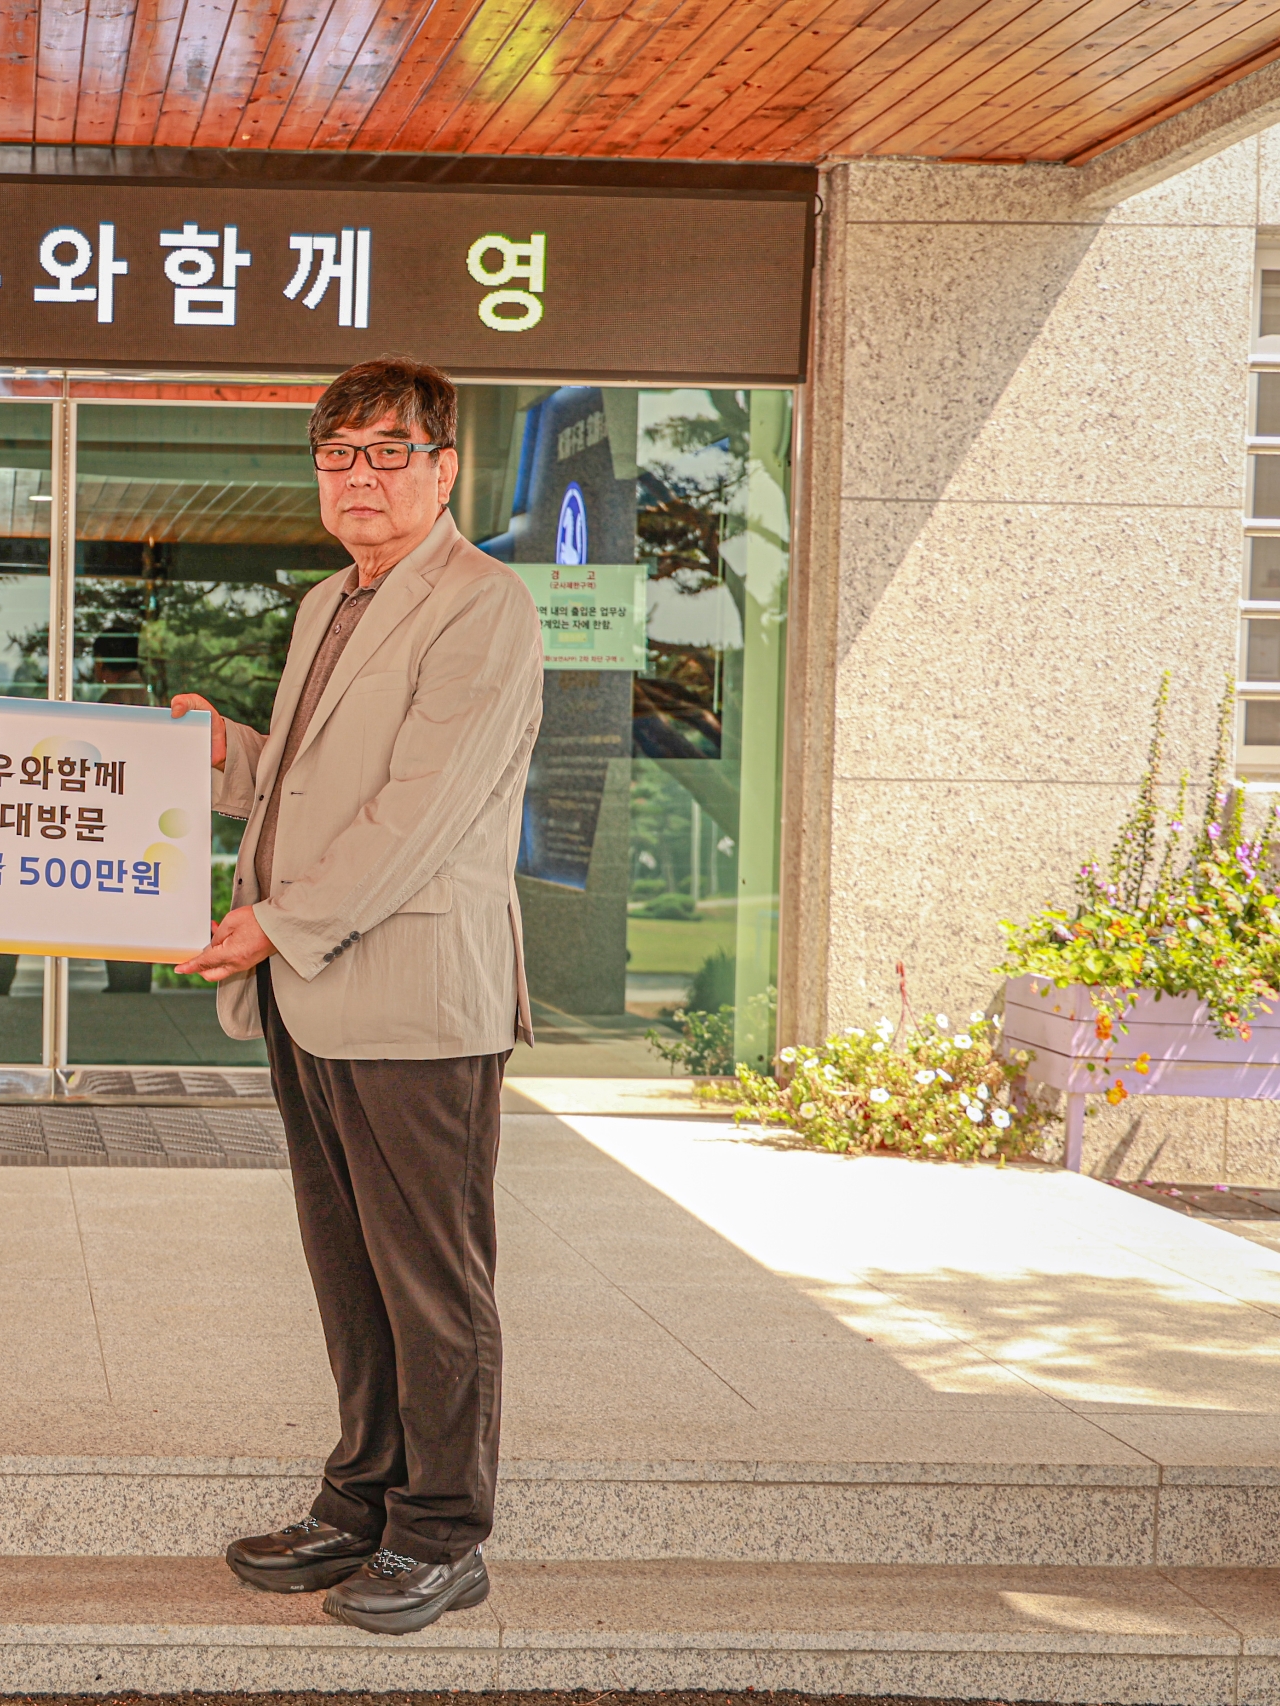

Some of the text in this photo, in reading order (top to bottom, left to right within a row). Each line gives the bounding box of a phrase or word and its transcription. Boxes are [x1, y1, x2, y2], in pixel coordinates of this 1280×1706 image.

[466, 232, 547, 332] 영
[551, 606, 569, 617] 내의
[571, 606, 597, 617] 출입은
[600, 606, 627, 617] 업무상
[572, 620, 590, 630] 자에
[20, 856, 162, 896] 500만원
